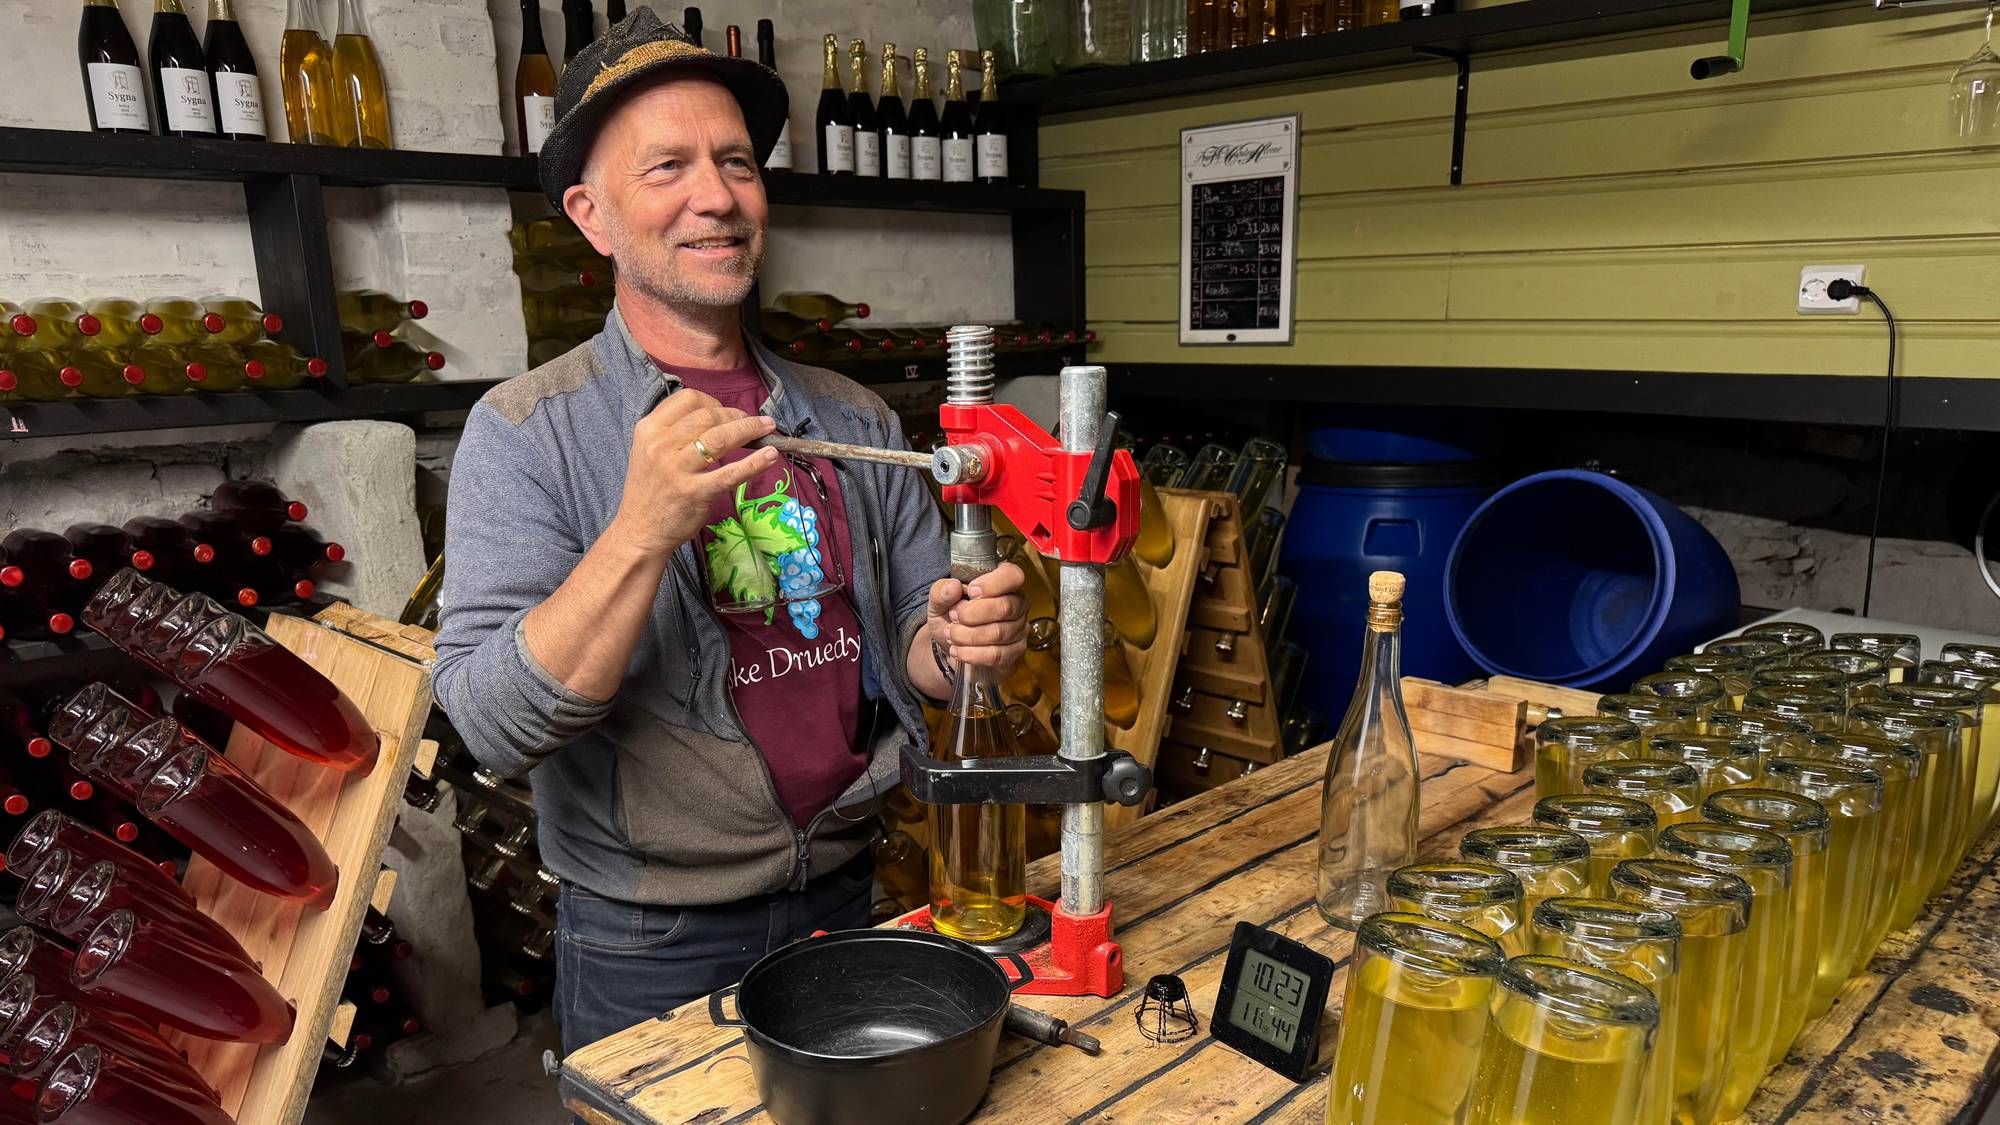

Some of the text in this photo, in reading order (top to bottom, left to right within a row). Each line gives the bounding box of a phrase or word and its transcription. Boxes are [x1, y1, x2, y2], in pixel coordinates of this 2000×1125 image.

[107, 91, 137, 102] Sygna
[180, 95, 207, 105] Sygna
[234, 98, 259, 109] Sygna
[766, 627, 861, 679] Druedy
